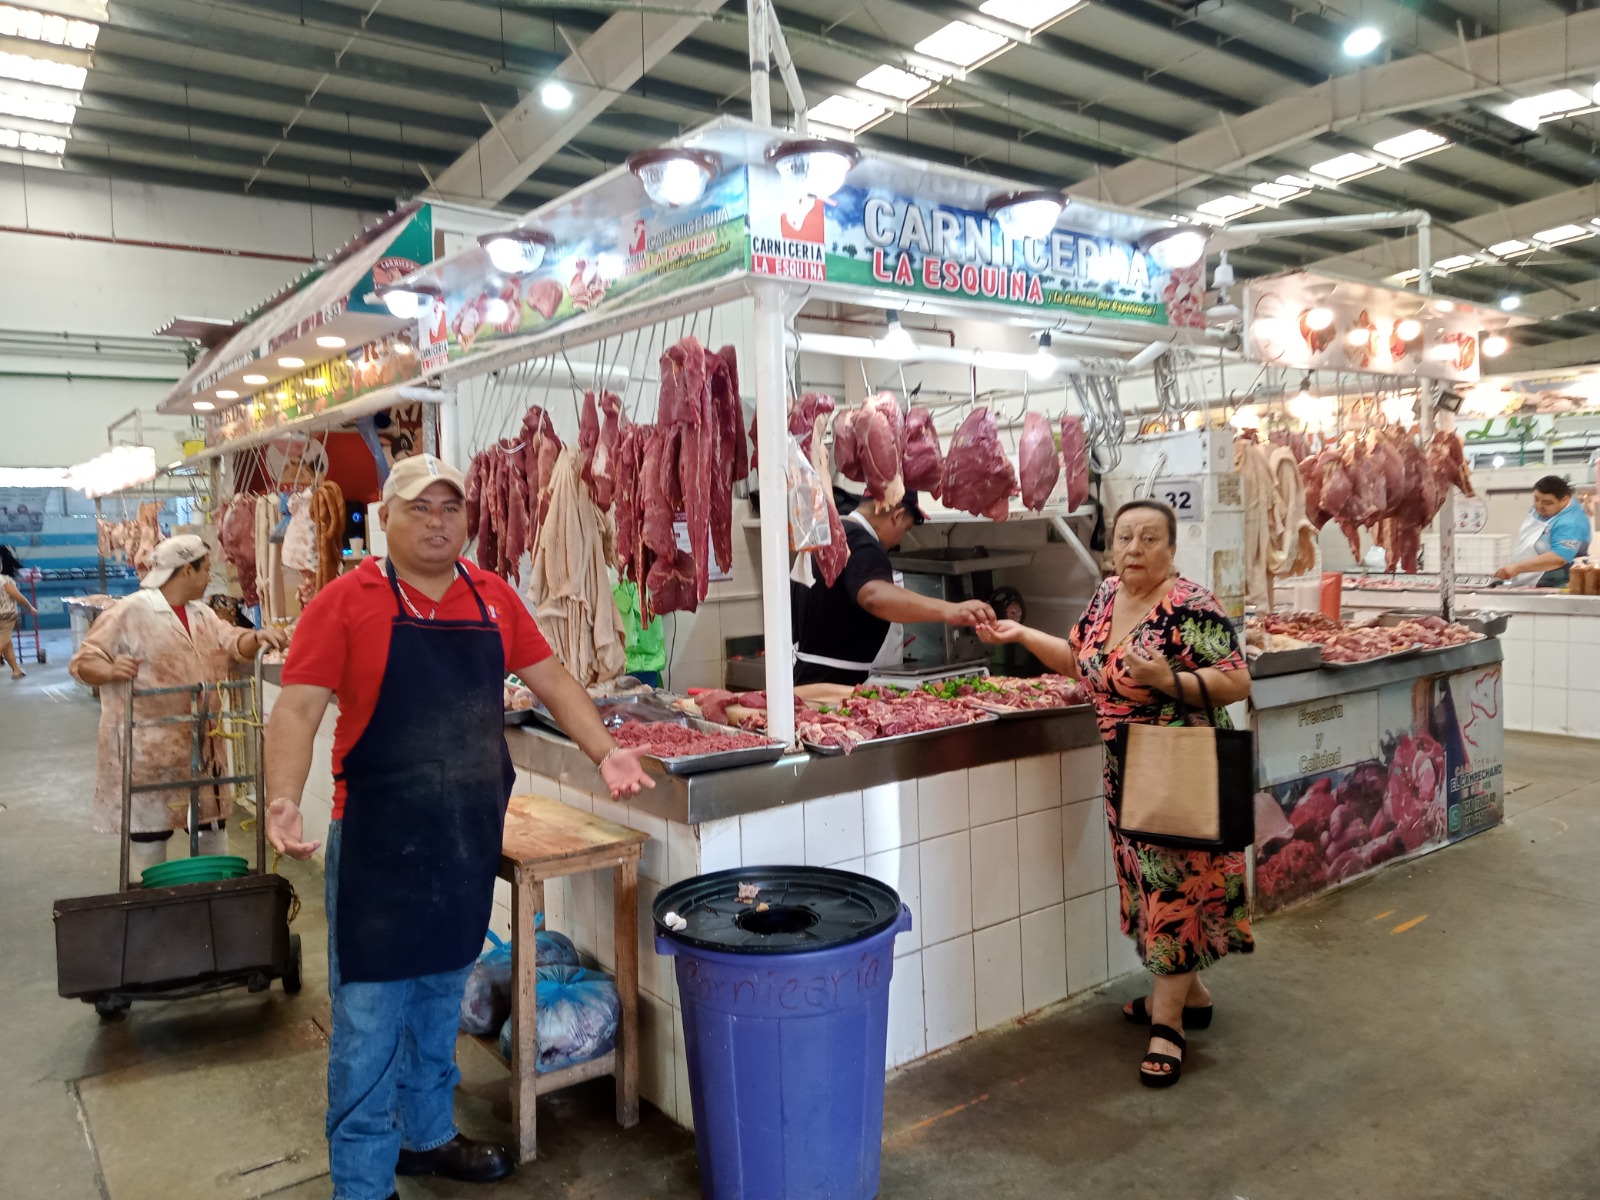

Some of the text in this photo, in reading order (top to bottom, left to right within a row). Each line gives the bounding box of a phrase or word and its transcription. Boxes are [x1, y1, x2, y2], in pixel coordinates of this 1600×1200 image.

[752, 236, 823, 262] CARNICERIA
[863, 199, 1151, 289] CARNICERA
[754, 255, 769, 274] LA
[775, 258, 825, 281] ESQUINA
[872, 248, 1045, 305] LA ESQUINA
[1298, 704, 1344, 728] Frescura
[1315, 732, 1324, 750] y
[1299, 746, 1342, 774] Calidad
